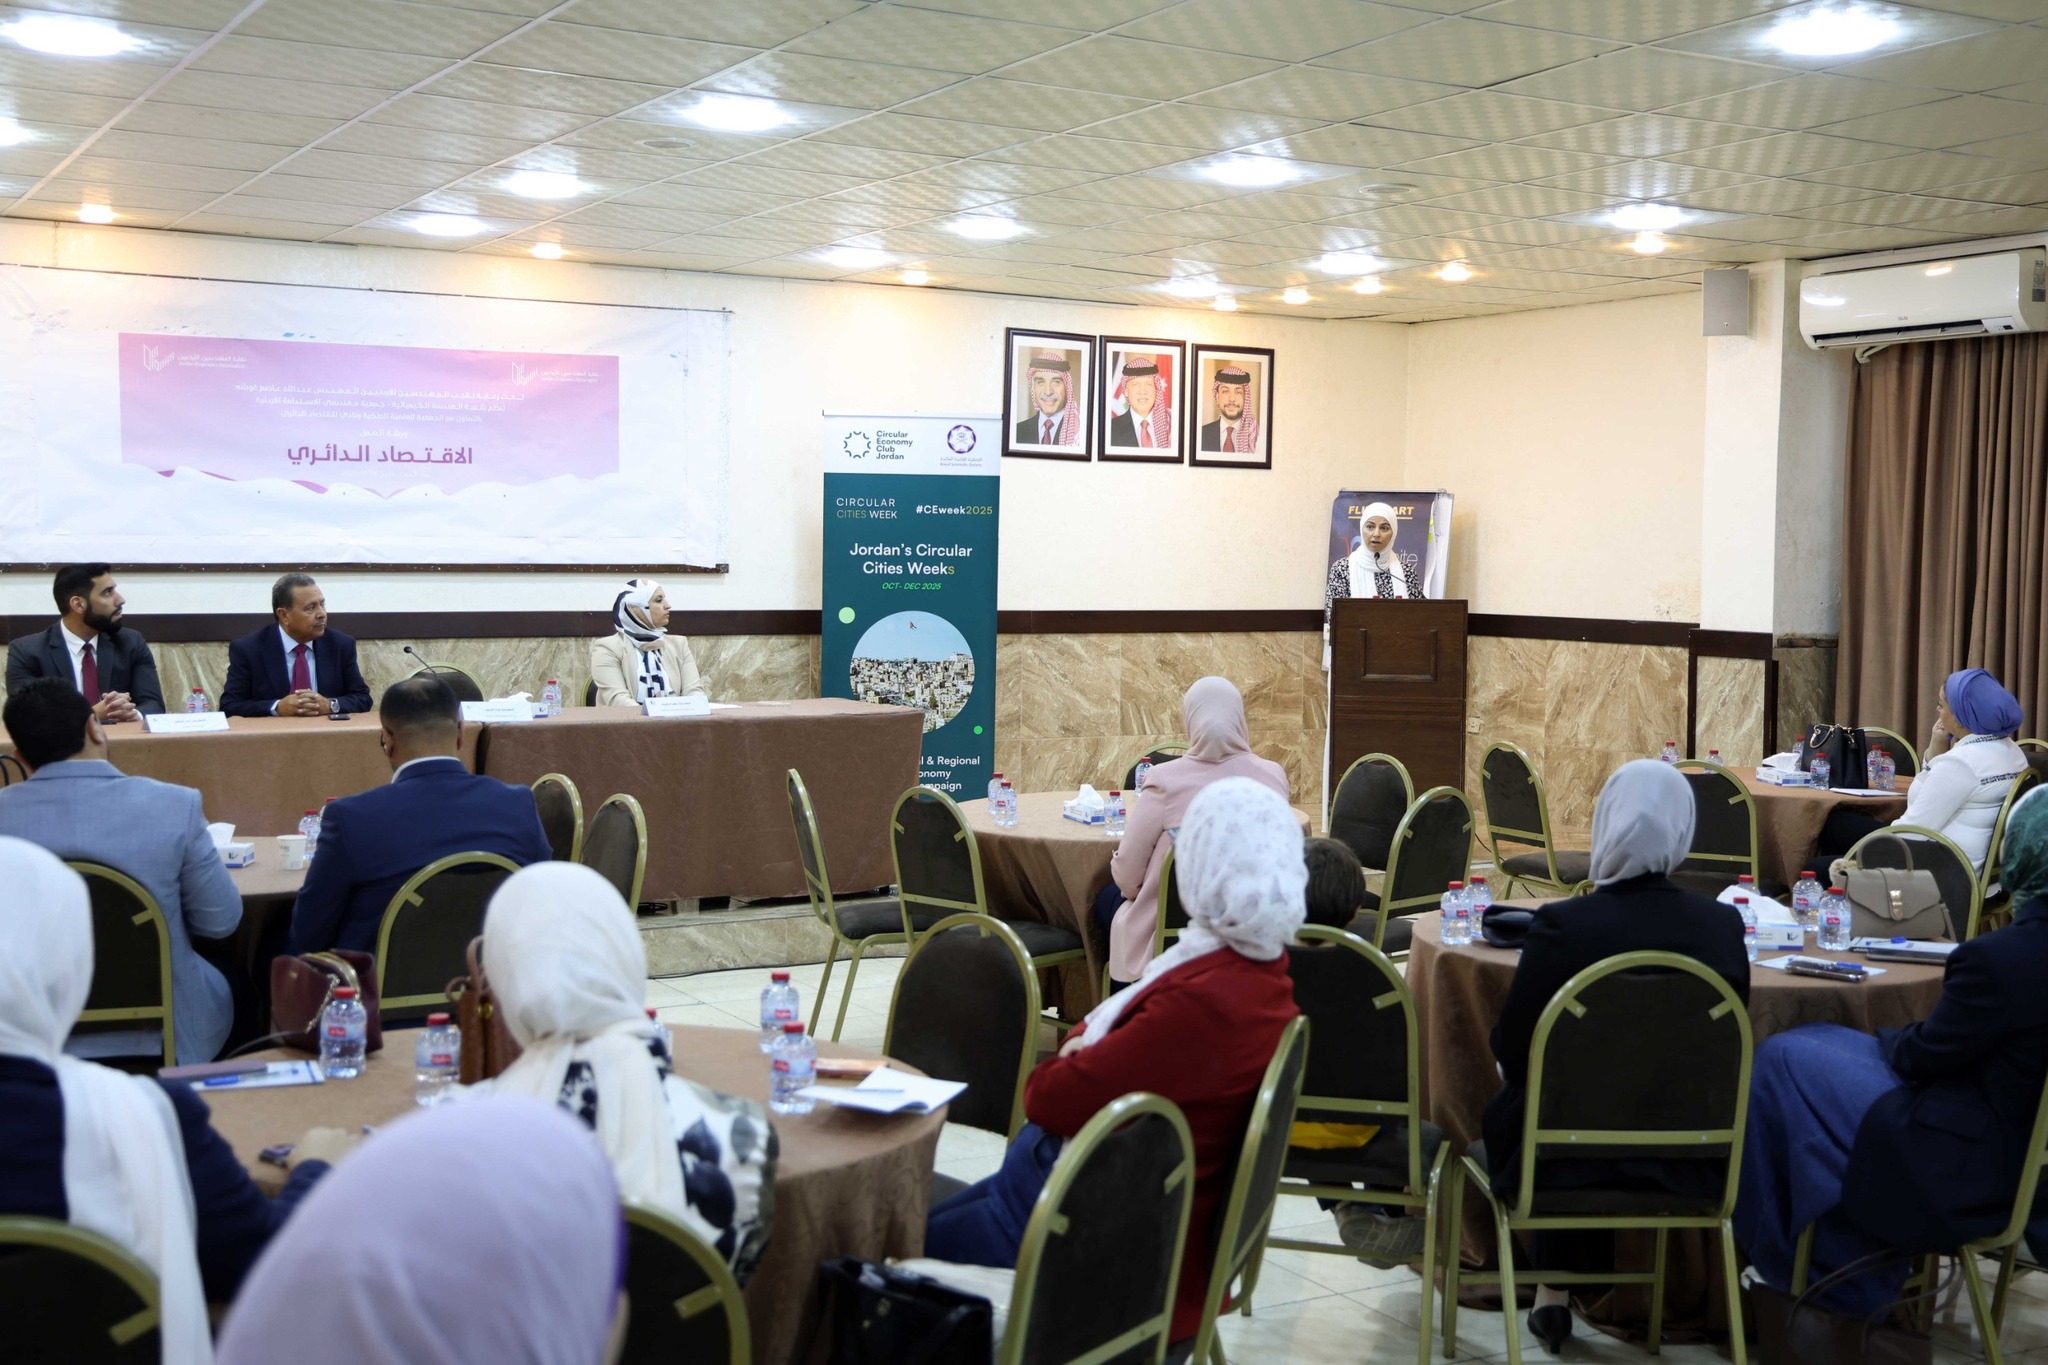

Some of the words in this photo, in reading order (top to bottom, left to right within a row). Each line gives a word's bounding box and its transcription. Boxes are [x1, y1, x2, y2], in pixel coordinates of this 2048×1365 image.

[876, 430, 909, 438] Circular
[876, 438, 914, 447] Economy
[876, 445, 896, 453] Club
[287, 444, 371, 466] الدائري
[377, 447, 473, 466] الاقتصاد
[836, 498, 896, 507] CIRCULAR
[836, 509, 867, 519] CITIES
[869, 510, 898, 519] WEEK
[915, 505, 993, 515] #CEweek2025
[1392, 506, 1415, 515] ART
[849, 543, 912, 556] Jordan’s
[915, 544, 973, 557] Circular
[863, 561, 904, 575] Cities
[907, 562, 955, 575] Weeks
[882, 582, 902, 590] OCT-
[903, 582, 921, 590] DEC
[921, 582, 942, 590] 2025
[926, 756, 935, 766] &
[937, 755, 980, 768] Regional
[918, 770, 952, 780] onomy
